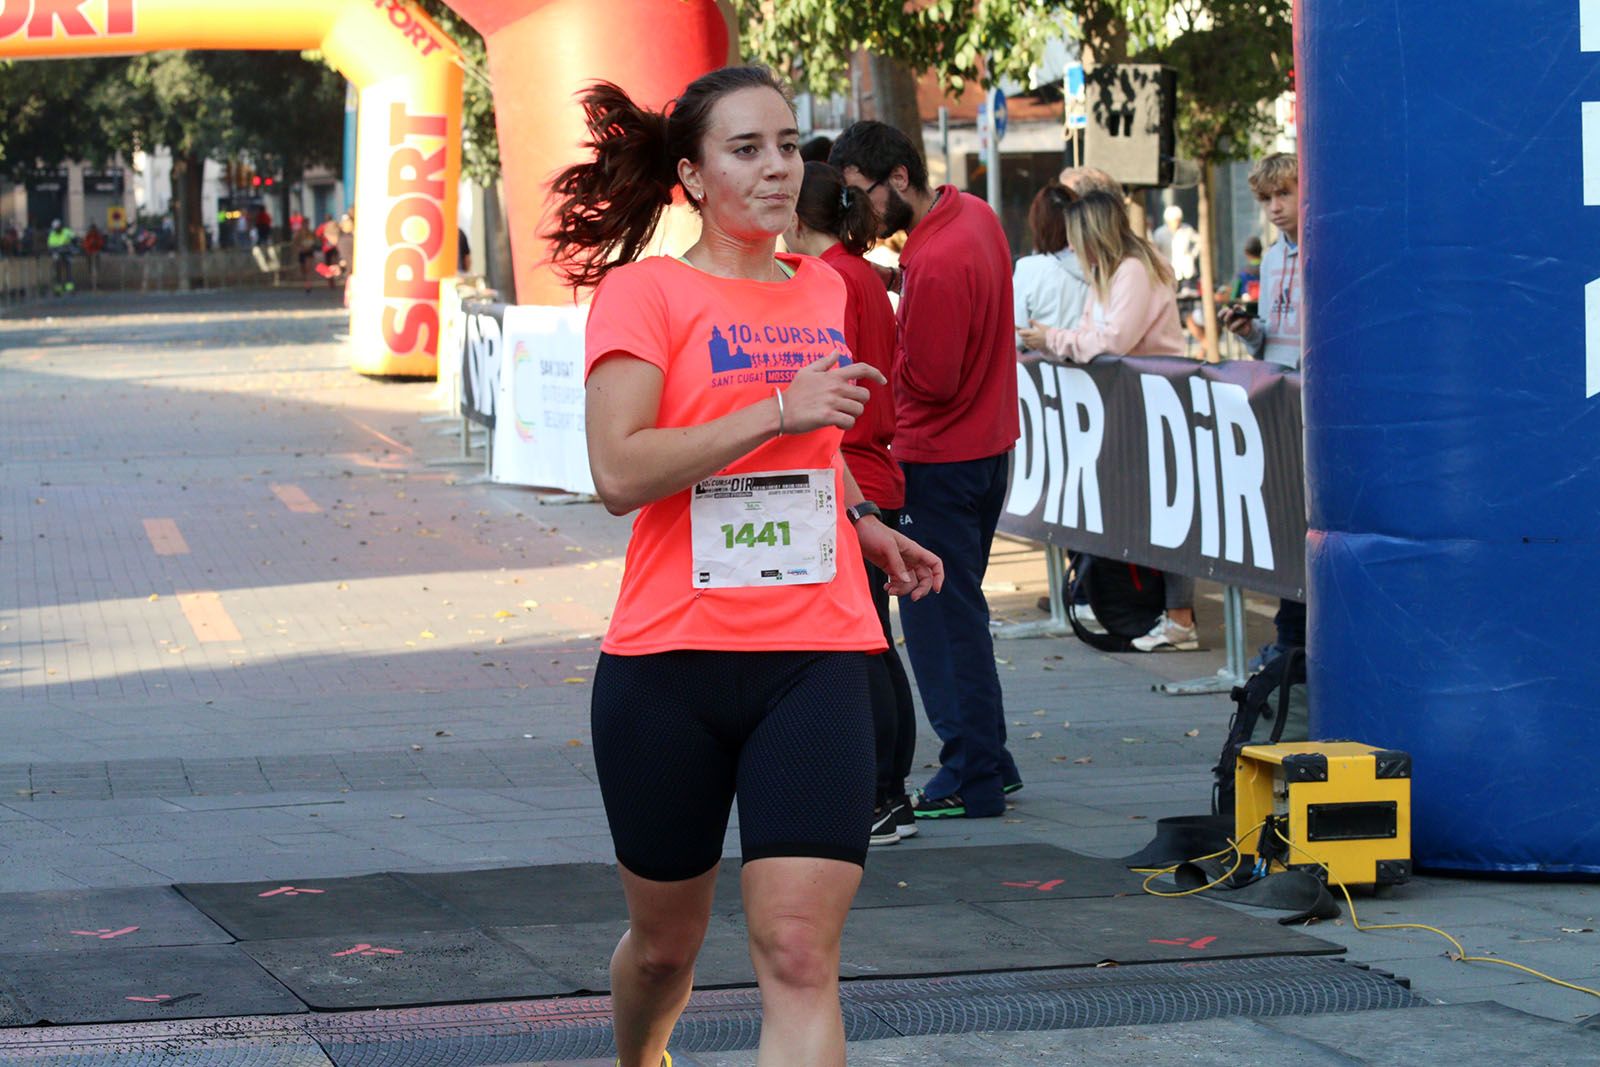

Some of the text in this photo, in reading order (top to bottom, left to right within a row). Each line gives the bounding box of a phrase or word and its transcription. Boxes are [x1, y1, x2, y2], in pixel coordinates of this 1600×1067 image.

[381, 102, 448, 358] SPORT
[764, 326, 828, 344] CURSA
[711, 375, 734, 388] SANT
[737, 372, 763, 384] CUGAT
[1140, 373, 1275, 571] DiR
[720, 520, 791, 549] 1441
